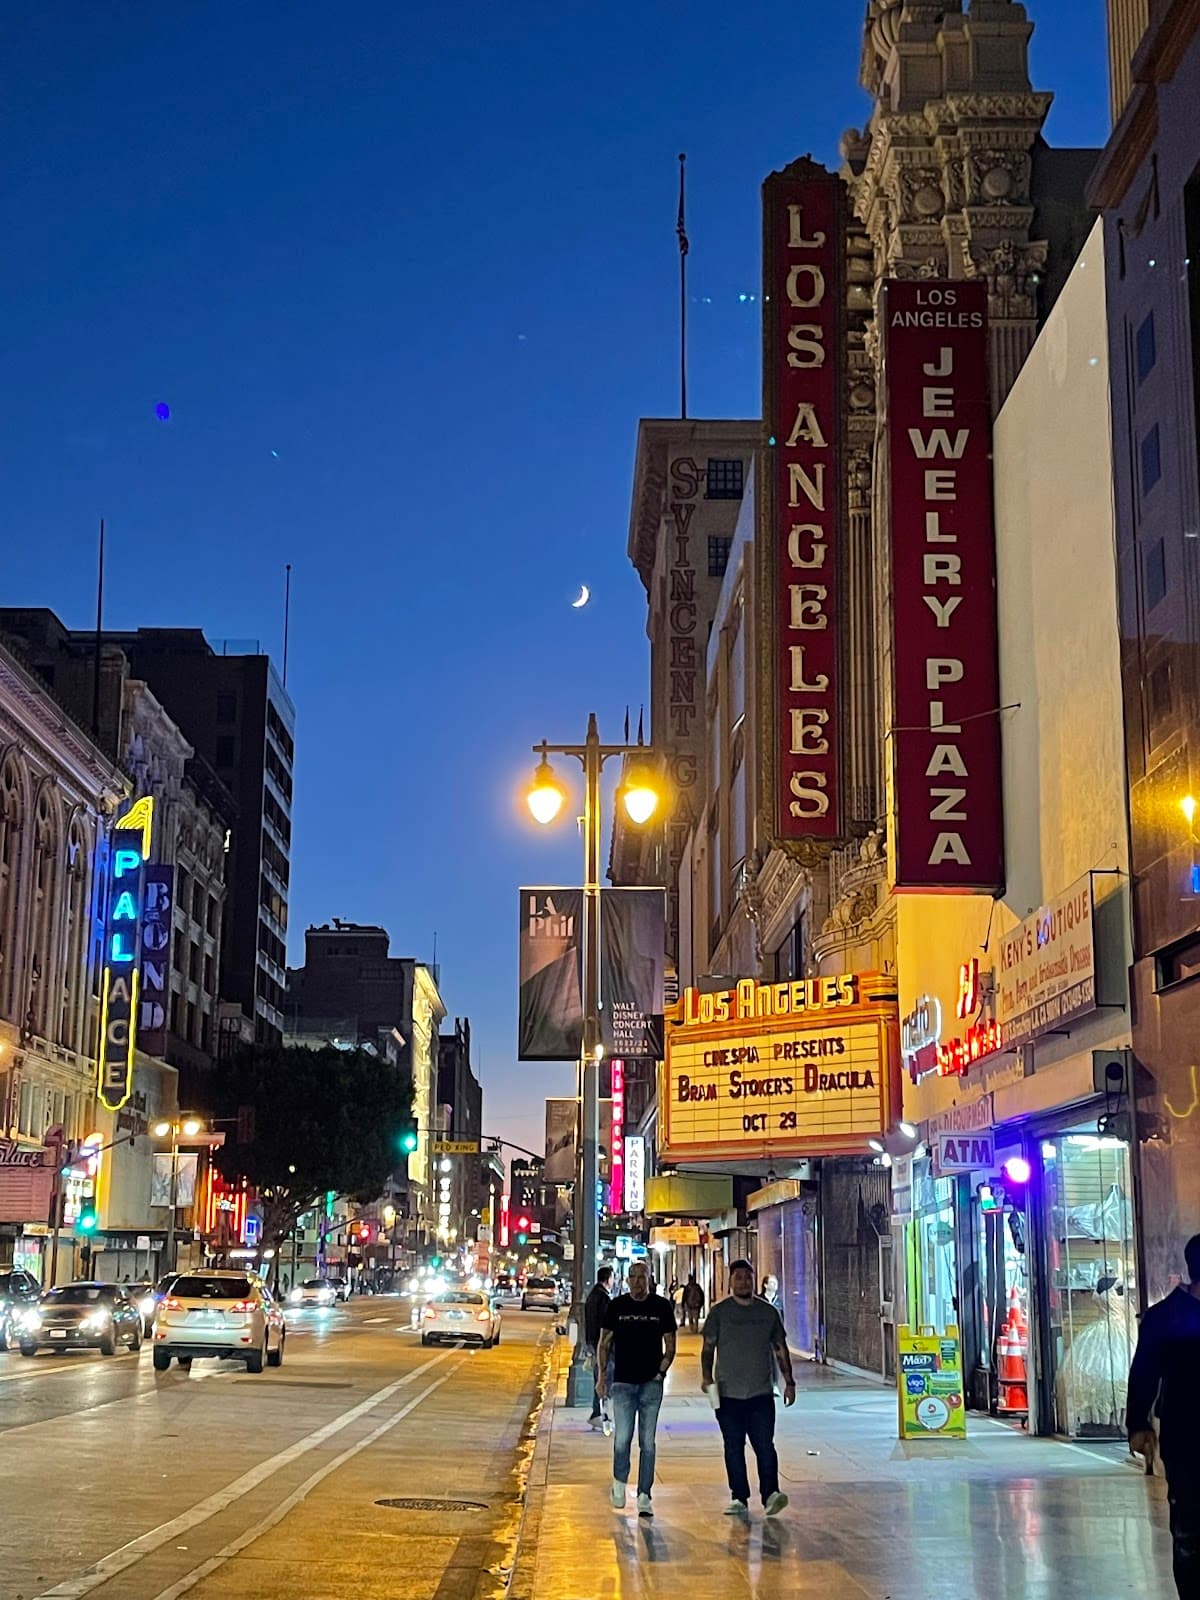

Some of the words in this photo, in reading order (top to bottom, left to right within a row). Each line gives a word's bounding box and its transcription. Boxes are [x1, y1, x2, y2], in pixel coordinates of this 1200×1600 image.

[786, 203, 826, 369] LOS
[916, 289, 957, 306] LOS
[891, 311, 983, 329] ANGELES
[908, 347, 970, 627] JEWELRY
[670, 503, 697, 738] VINCENT
[785, 402, 830, 818] ANGELES
[925, 658, 972, 865] PLAZA
[529, 896, 557, 915] LA
[529, 916, 574, 937] Phil
[1000, 927, 1033, 973] KENY'S
[1036, 889, 1089, 951] BOUTIQUE
[104, 850, 140, 1088] PALACE
[140, 882, 169, 1031] BOND
[613, 1002, 636, 1010] WALT
[684, 987, 729, 1026] LOS
[738, 974, 855, 1018] ANGELES
[613, 1012, 644, 1020] DISNEY
[613, 1020, 652, 1029] CONCERT
[613, 1030, 634, 1038] HALL
[703, 1046, 760, 1066] CINESPIA
[774, 1037, 845, 1060] PRESENTS
[678, 1075, 717, 1102] BRAM
[729, 1071, 793, 1098] STOKER'S
[804, 1064, 874, 1092] DRACULA
[743, 1114, 767, 1132] OCT
[780, 1111, 797, 1129] 29
[0, 1143, 41, 1167] alace
[434, 1143, 451, 1151] PED
[944, 1139, 991, 1163] ATM
[629, 1139, 639, 1210] PARKING
